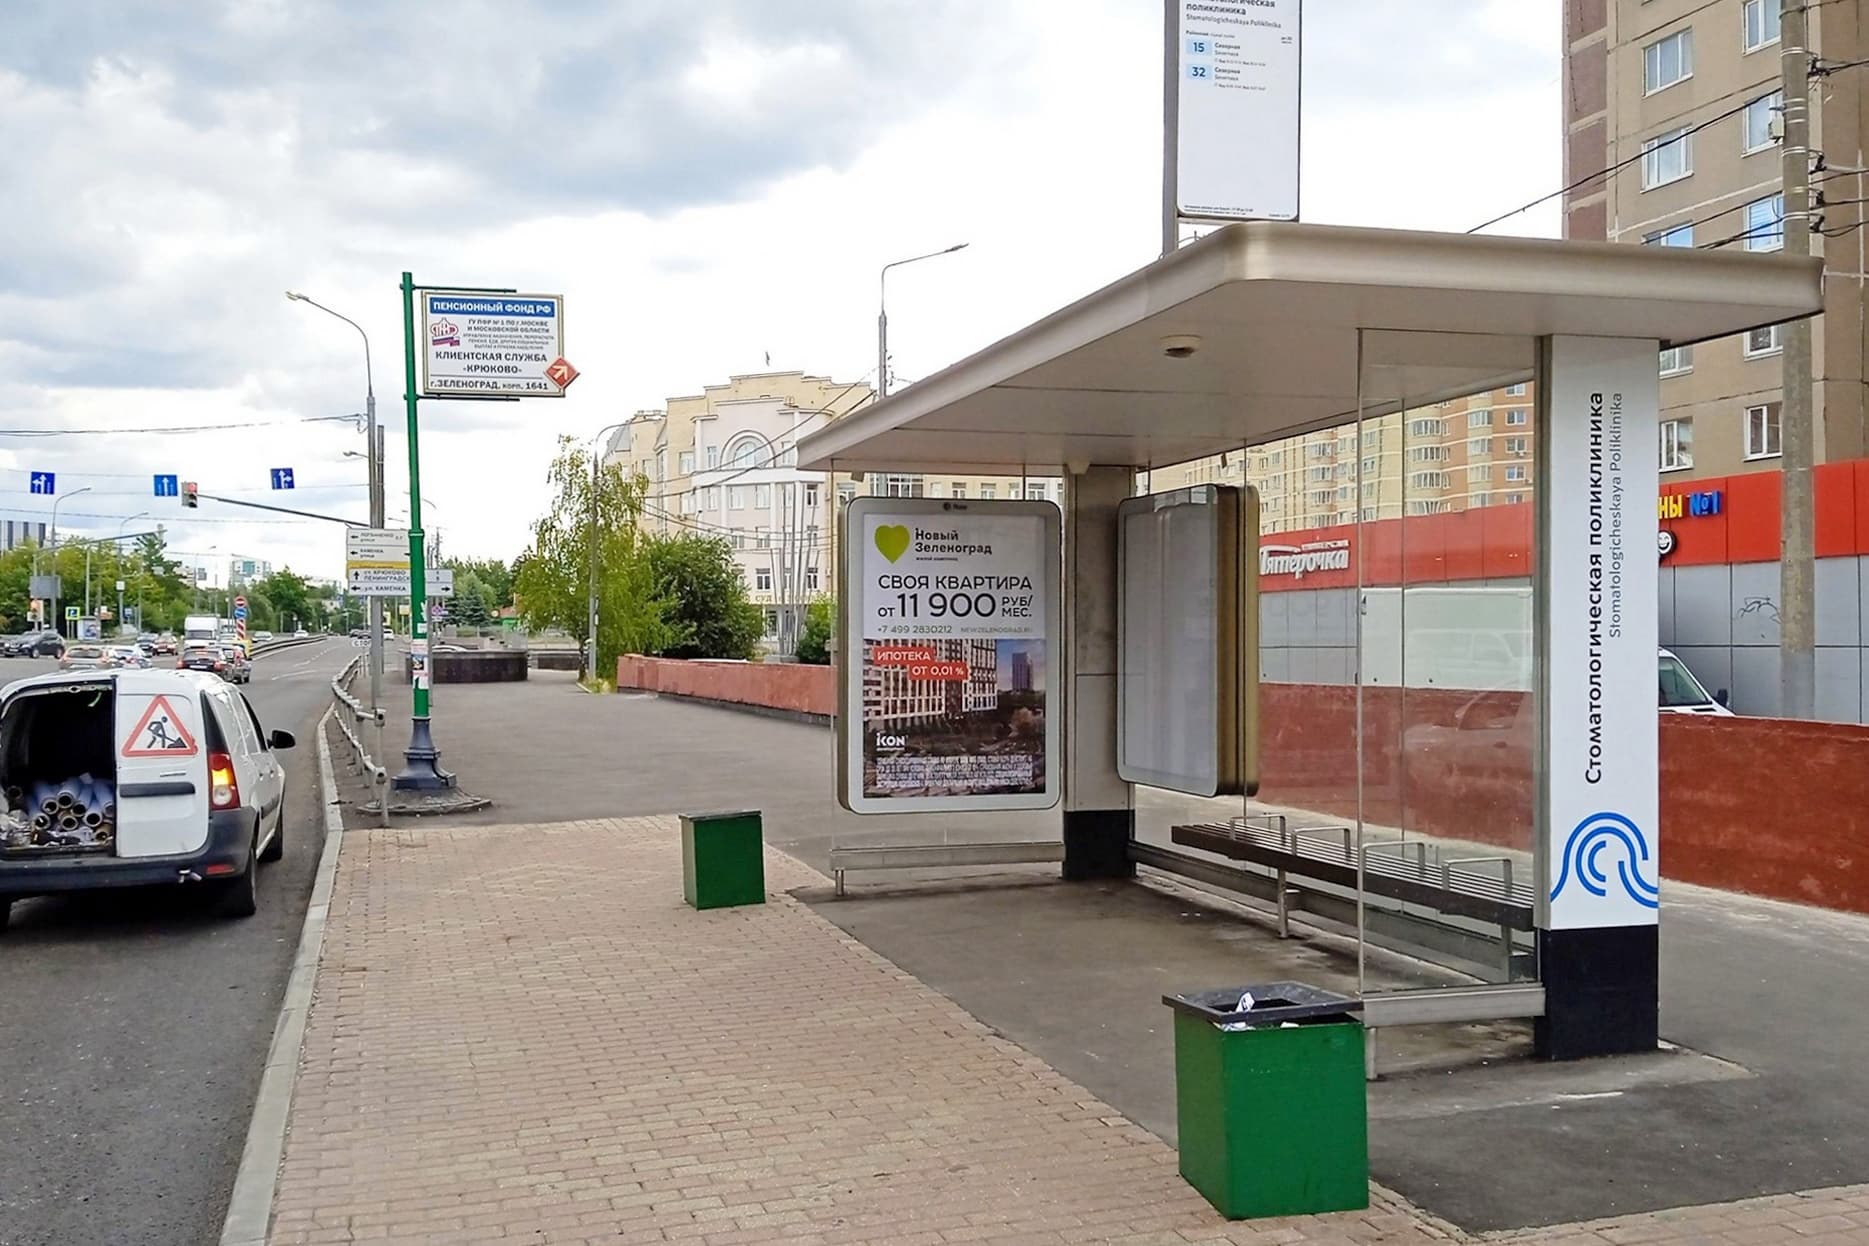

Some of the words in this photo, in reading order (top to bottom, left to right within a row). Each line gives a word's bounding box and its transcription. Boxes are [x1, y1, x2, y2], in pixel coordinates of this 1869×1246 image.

[1186, 3, 1247, 15] поликлиника
[1193, 42, 1205, 53] 15
[1192, 66, 1206, 77] 32
[433, 301, 503, 312] ПЕНСИОННЫЙ
[504, 303, 535, 314] ФОНД
[536, 304, 552, 313] РФ
[435, 351, 502, 361] КЛИЕНТСКАЯ
[504, 352, 548, 362] СЛУЖБА
[526, 382, 548, 390] 1641
[1609, 392, 1622, 472] Poliklinika
[1589, 392, 1603, 546] поликлиника
[915, 527, 959, 541] Новый
[915, 542, 993, 556] Зеленоград
[1609, 476, 1624, 639] Stomatologicheskaya
[878, 575, 929, 589] СВОЯ
[936, 576, 1033, 590] КВАРТИРА
[897, 593, 919, 618] 11
[928, 592, 997, 618] 900
[1001, 595, 1033, 607] РУБ/
[1001, 607, 1033, 617] МЕС.
[877, 625, 888, 634] +7
[890, 625, 910, 634] 499
[912, 625, 953, 634] 2830212
[877, 651, 932, 661] ИПОТЕКА
[912, 665, 927, 676] ОТ
[1585, 553, 1603, 785] Стоматологическая
